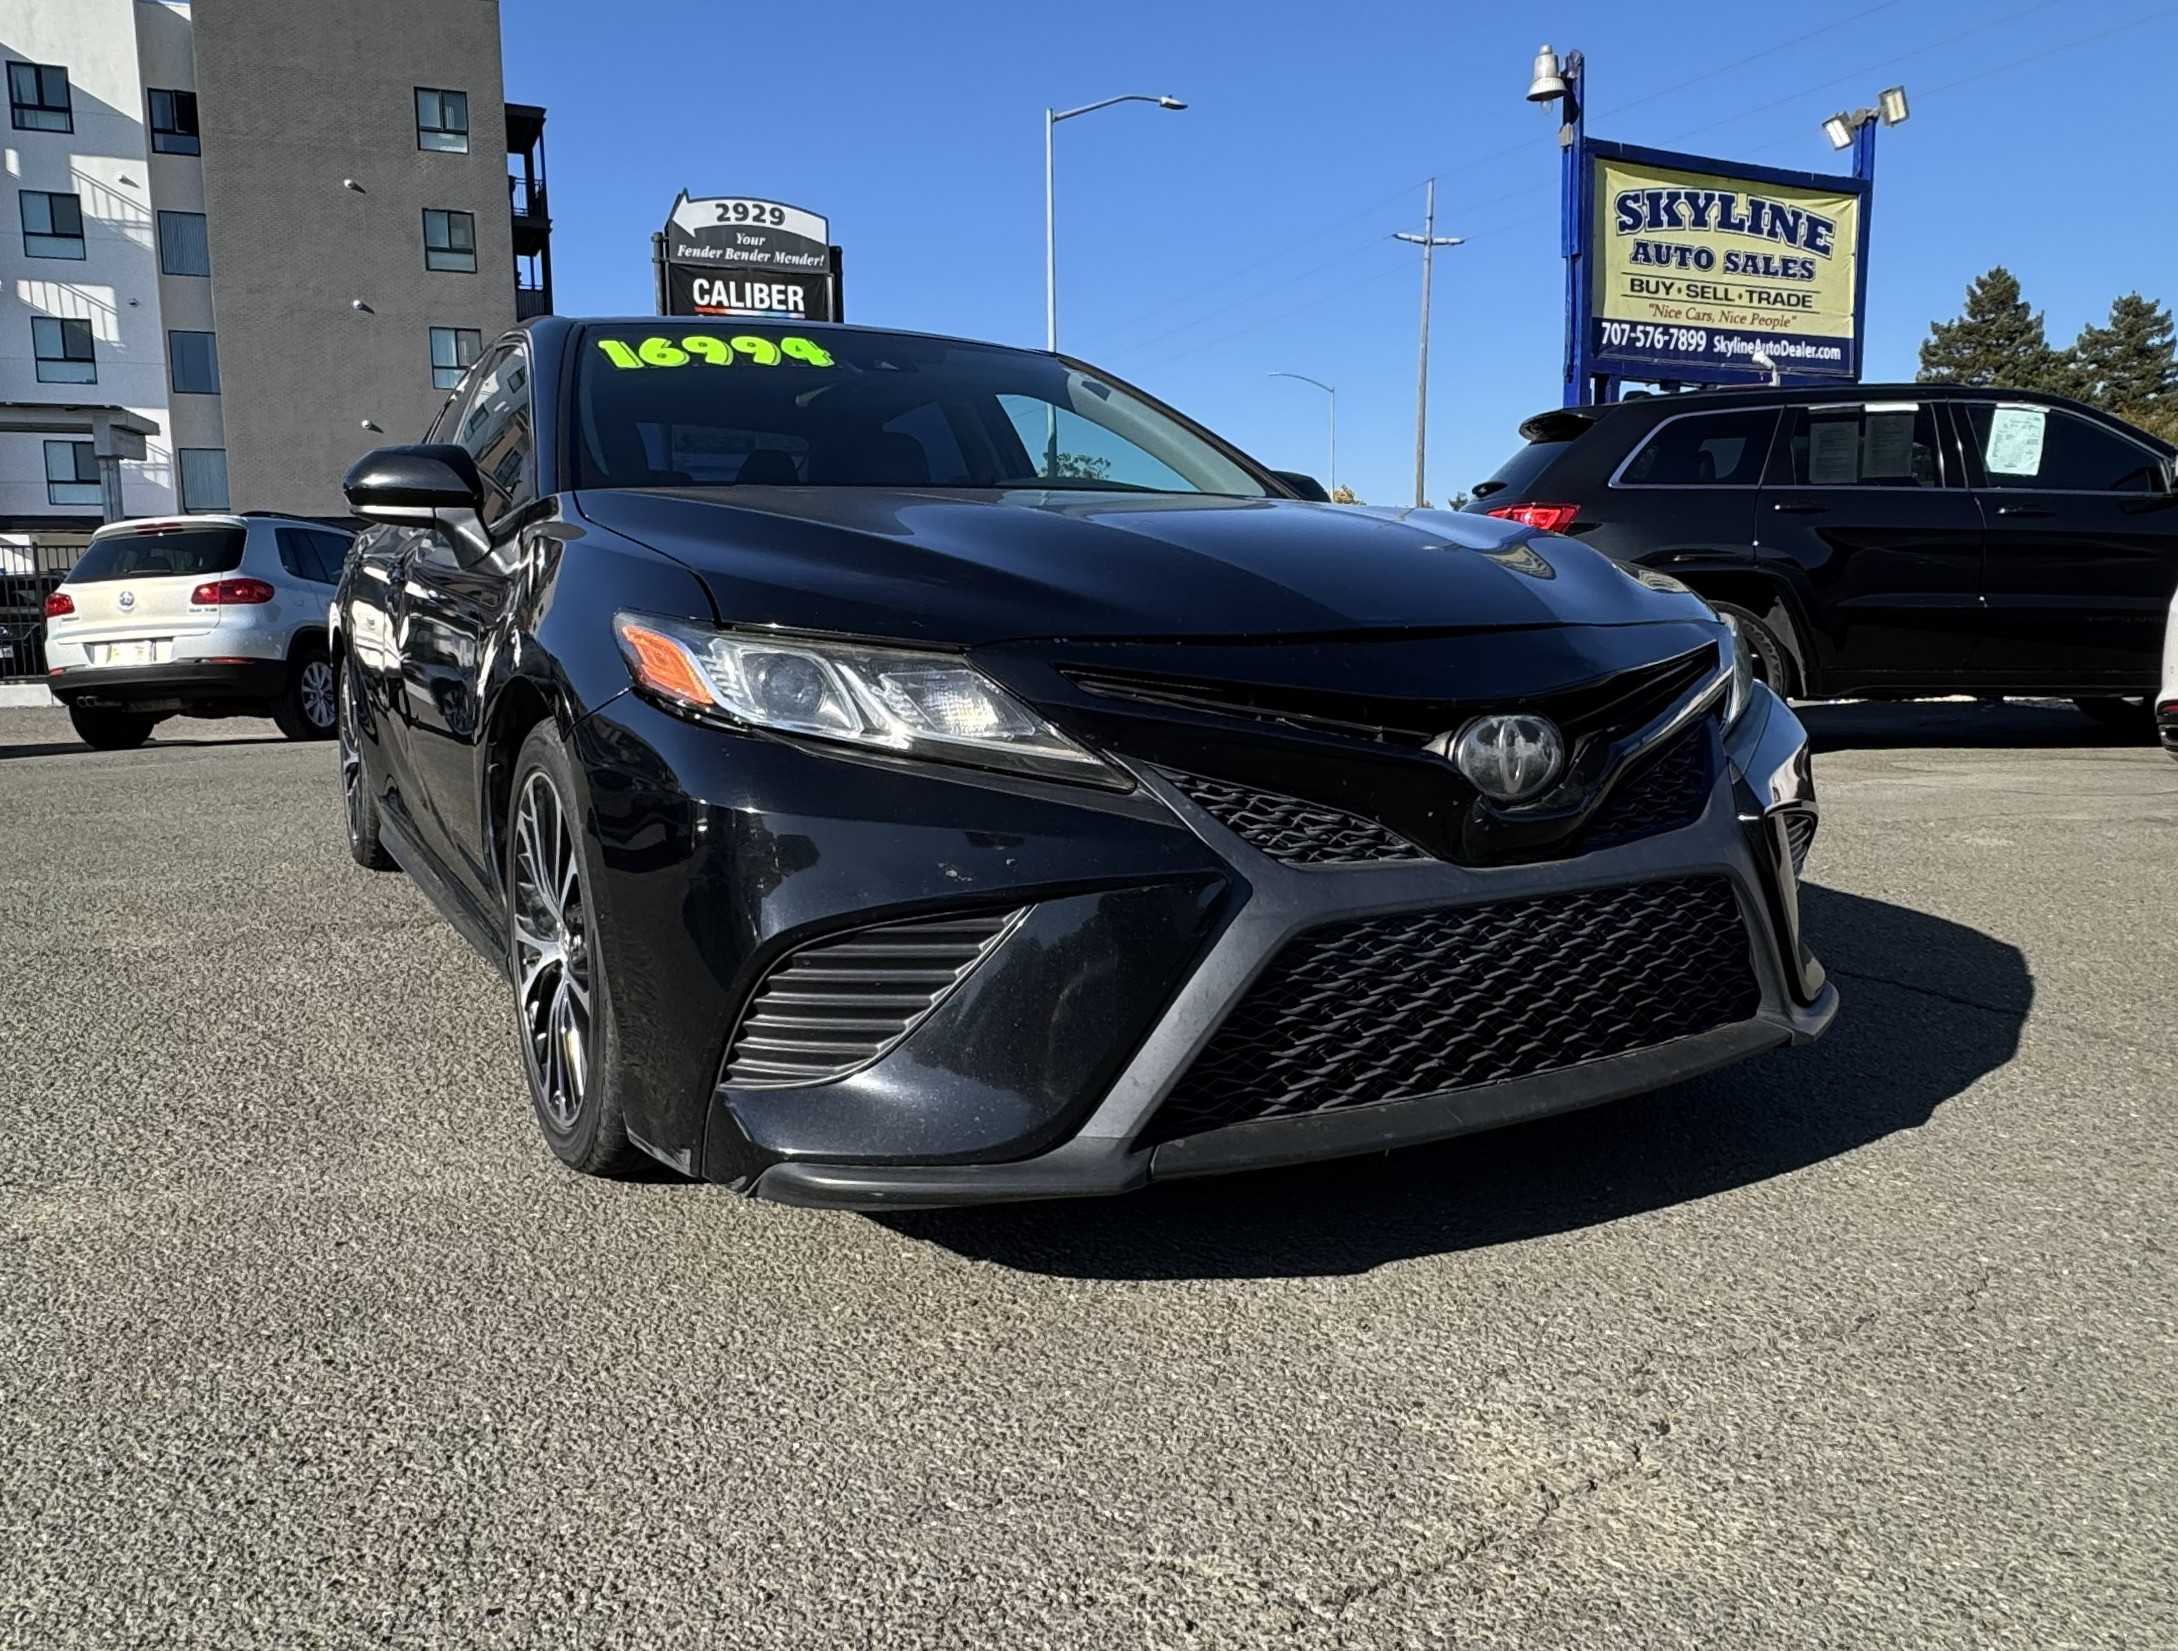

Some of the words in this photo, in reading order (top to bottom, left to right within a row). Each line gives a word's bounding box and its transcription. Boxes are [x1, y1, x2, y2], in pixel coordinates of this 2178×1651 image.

[715, 203, 785, 226] 2929
[1615, 187, 1837, 259] SKYLINE
[736, 232, 765, 246] Your
[677, 244, 722, 258] Fender
[725, 248, 770, 262] Bender
[773, 252, 825, 267] Mender!
[1629, 240, 1716, 271] AUTO
[1723, 251, 1816, 282] SALES
[693, 278, 805, 312] CALIBER
[1629, 278, 1674, 296] BUY
[1685, 283, 1735, 302] SELL
[1745, 289, 1813, 309] TRADE
[1648, 303, 1682, 320] "Nice
[1685, 307, 1715, 323] Cars,
[1719, 311, 1747, 326] Nice
[1750, 313, 1797, 330] People"
[598, 336, 835, 369] 16994
[1601, 322, 1707, 352] 707-576-7899
[1713, 335, 1841, 361] SkylineAutoDealer.com
